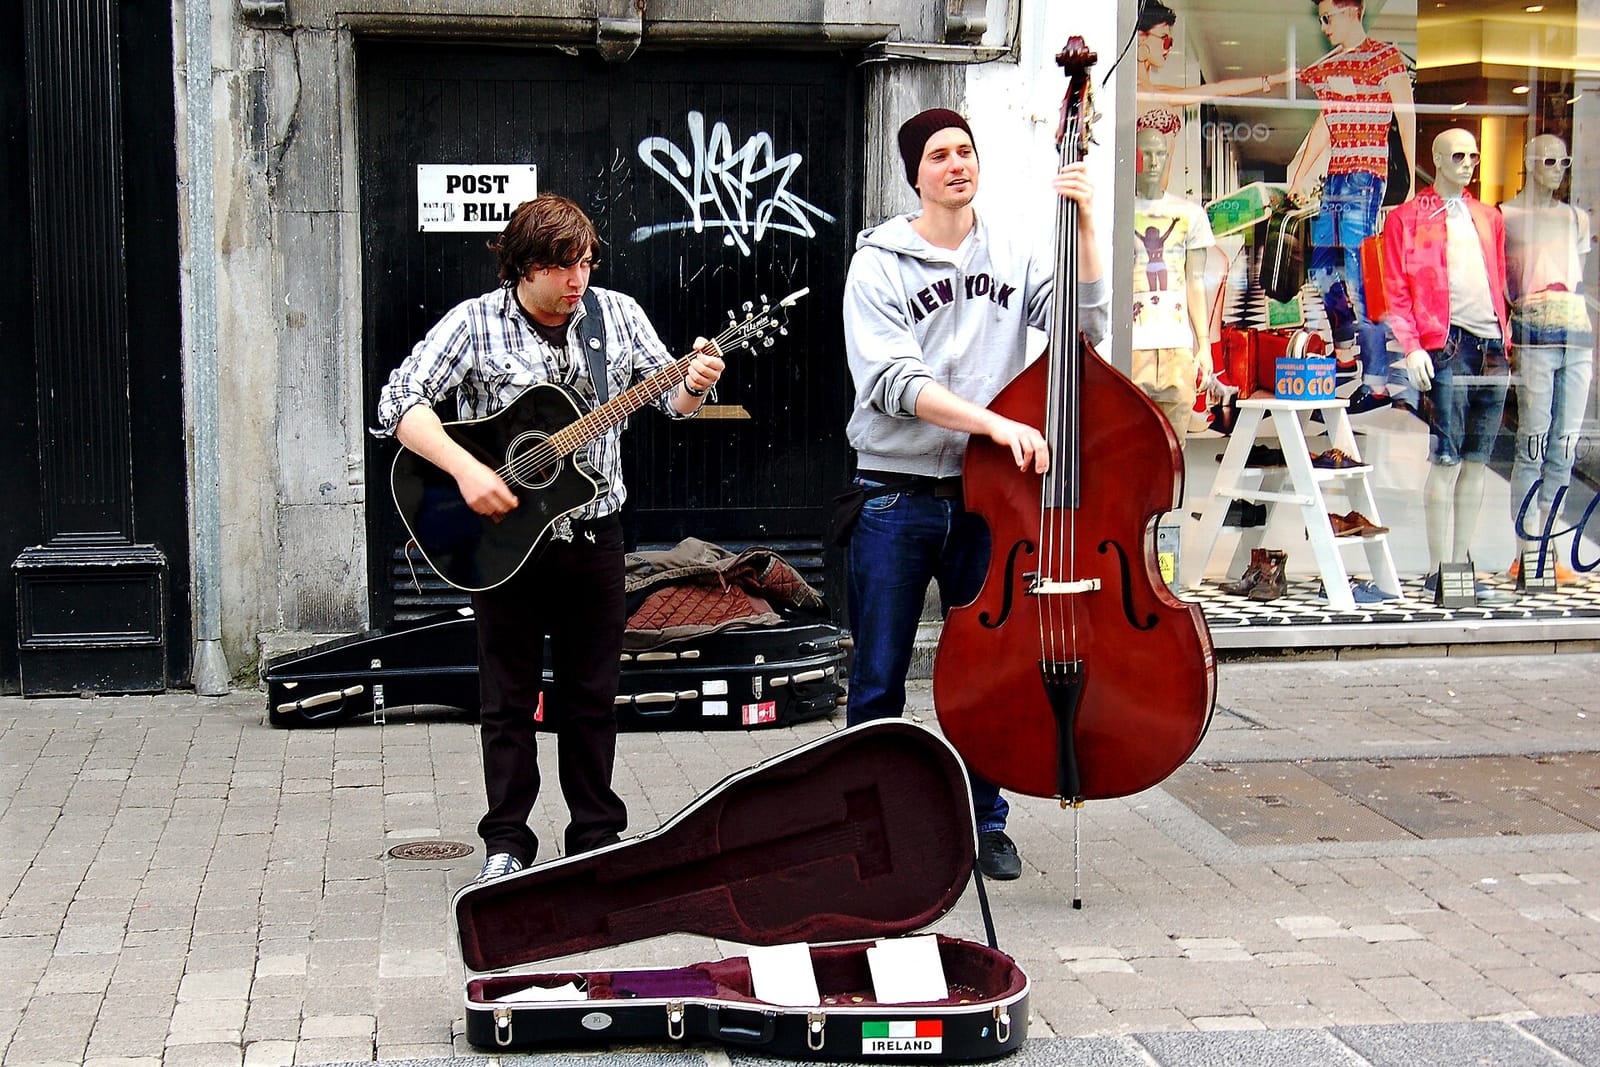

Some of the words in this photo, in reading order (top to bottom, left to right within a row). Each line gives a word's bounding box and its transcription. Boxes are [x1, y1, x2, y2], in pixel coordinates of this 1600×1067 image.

[446, 175, 509, 194] POST
[463, 203, 513, 222] BILL
[1278, 378, 1305, 395] €10
[1308, 378, 1335, 395] €10
[872, 1040, 932, 1052] IRELAND
